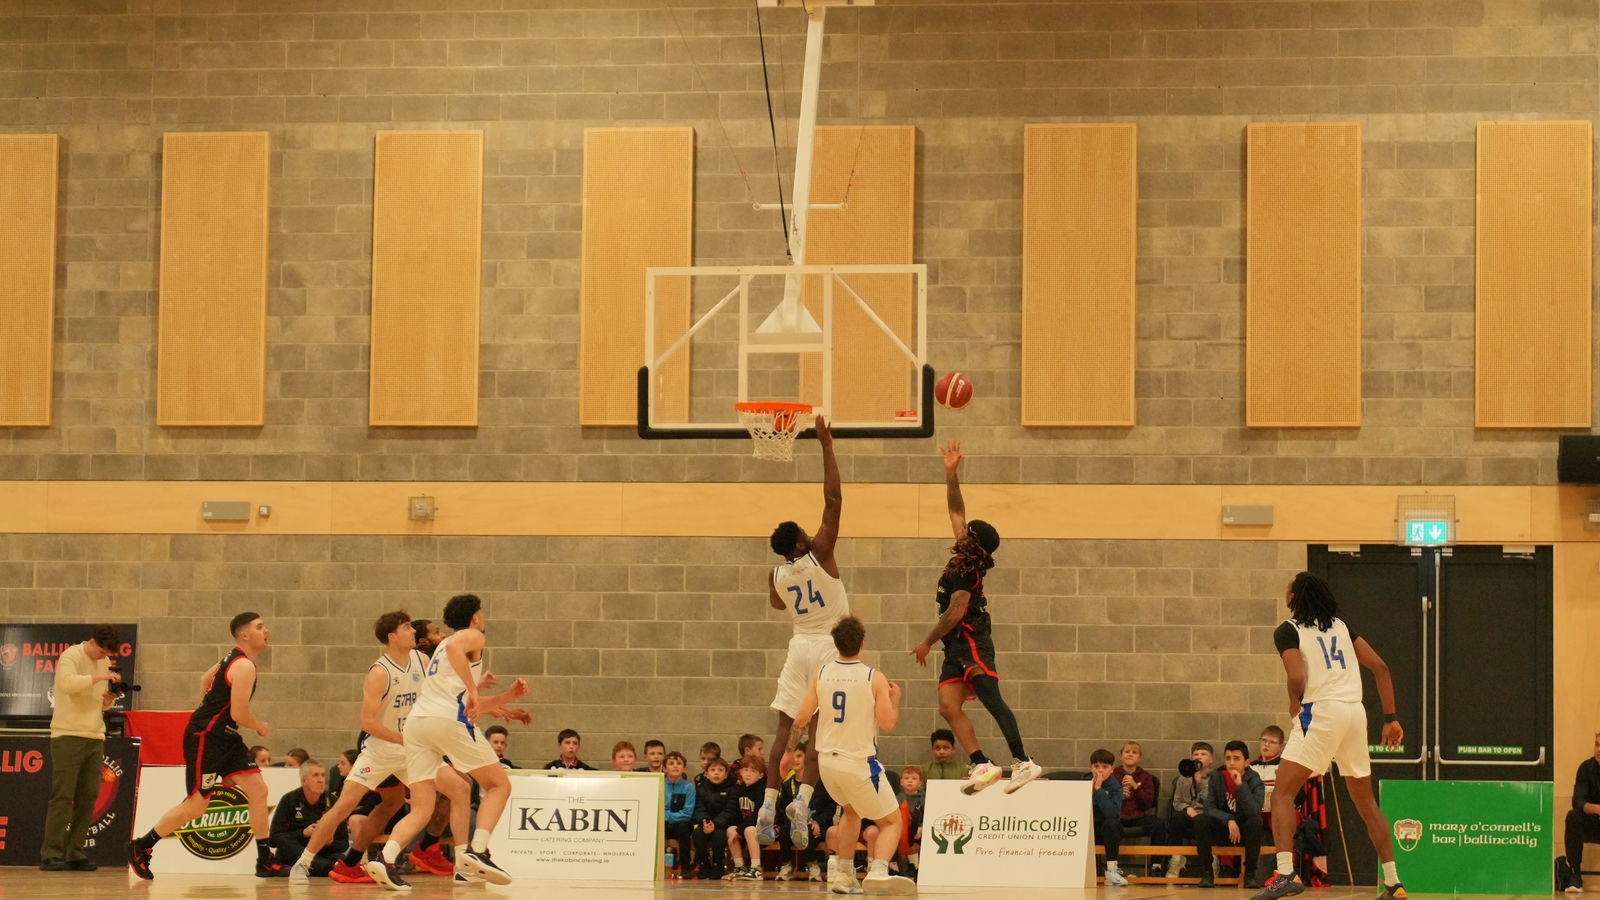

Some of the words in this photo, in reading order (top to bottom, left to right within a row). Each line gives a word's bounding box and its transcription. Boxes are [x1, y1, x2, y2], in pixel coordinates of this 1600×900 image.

[787, 579, 826, 615] 24
[1316, 635, 1346, 670] 14
[832, 690, 847, 724] 9
[0, 750, 44, 773] LIG
[566, 796, 586, 804] THE
[517, 807, 631, 832] KABIN
[978, 815, 1079, 838] Ballincollig
[1429, 823, 1469, 834] mary
[1469, 821, 1541, 832] o'connell's
[207, 846, 228, 855] Quality
[229, 832, 247, 849] Service
[975, 846, 996, 856] Pure
[998, 846, 1036, 858] financial
[1037, 847, 1077, 859] freedom
[1432, 834, 1457, 844] bar
[1463, 834, 1537, 848] ballincollig
